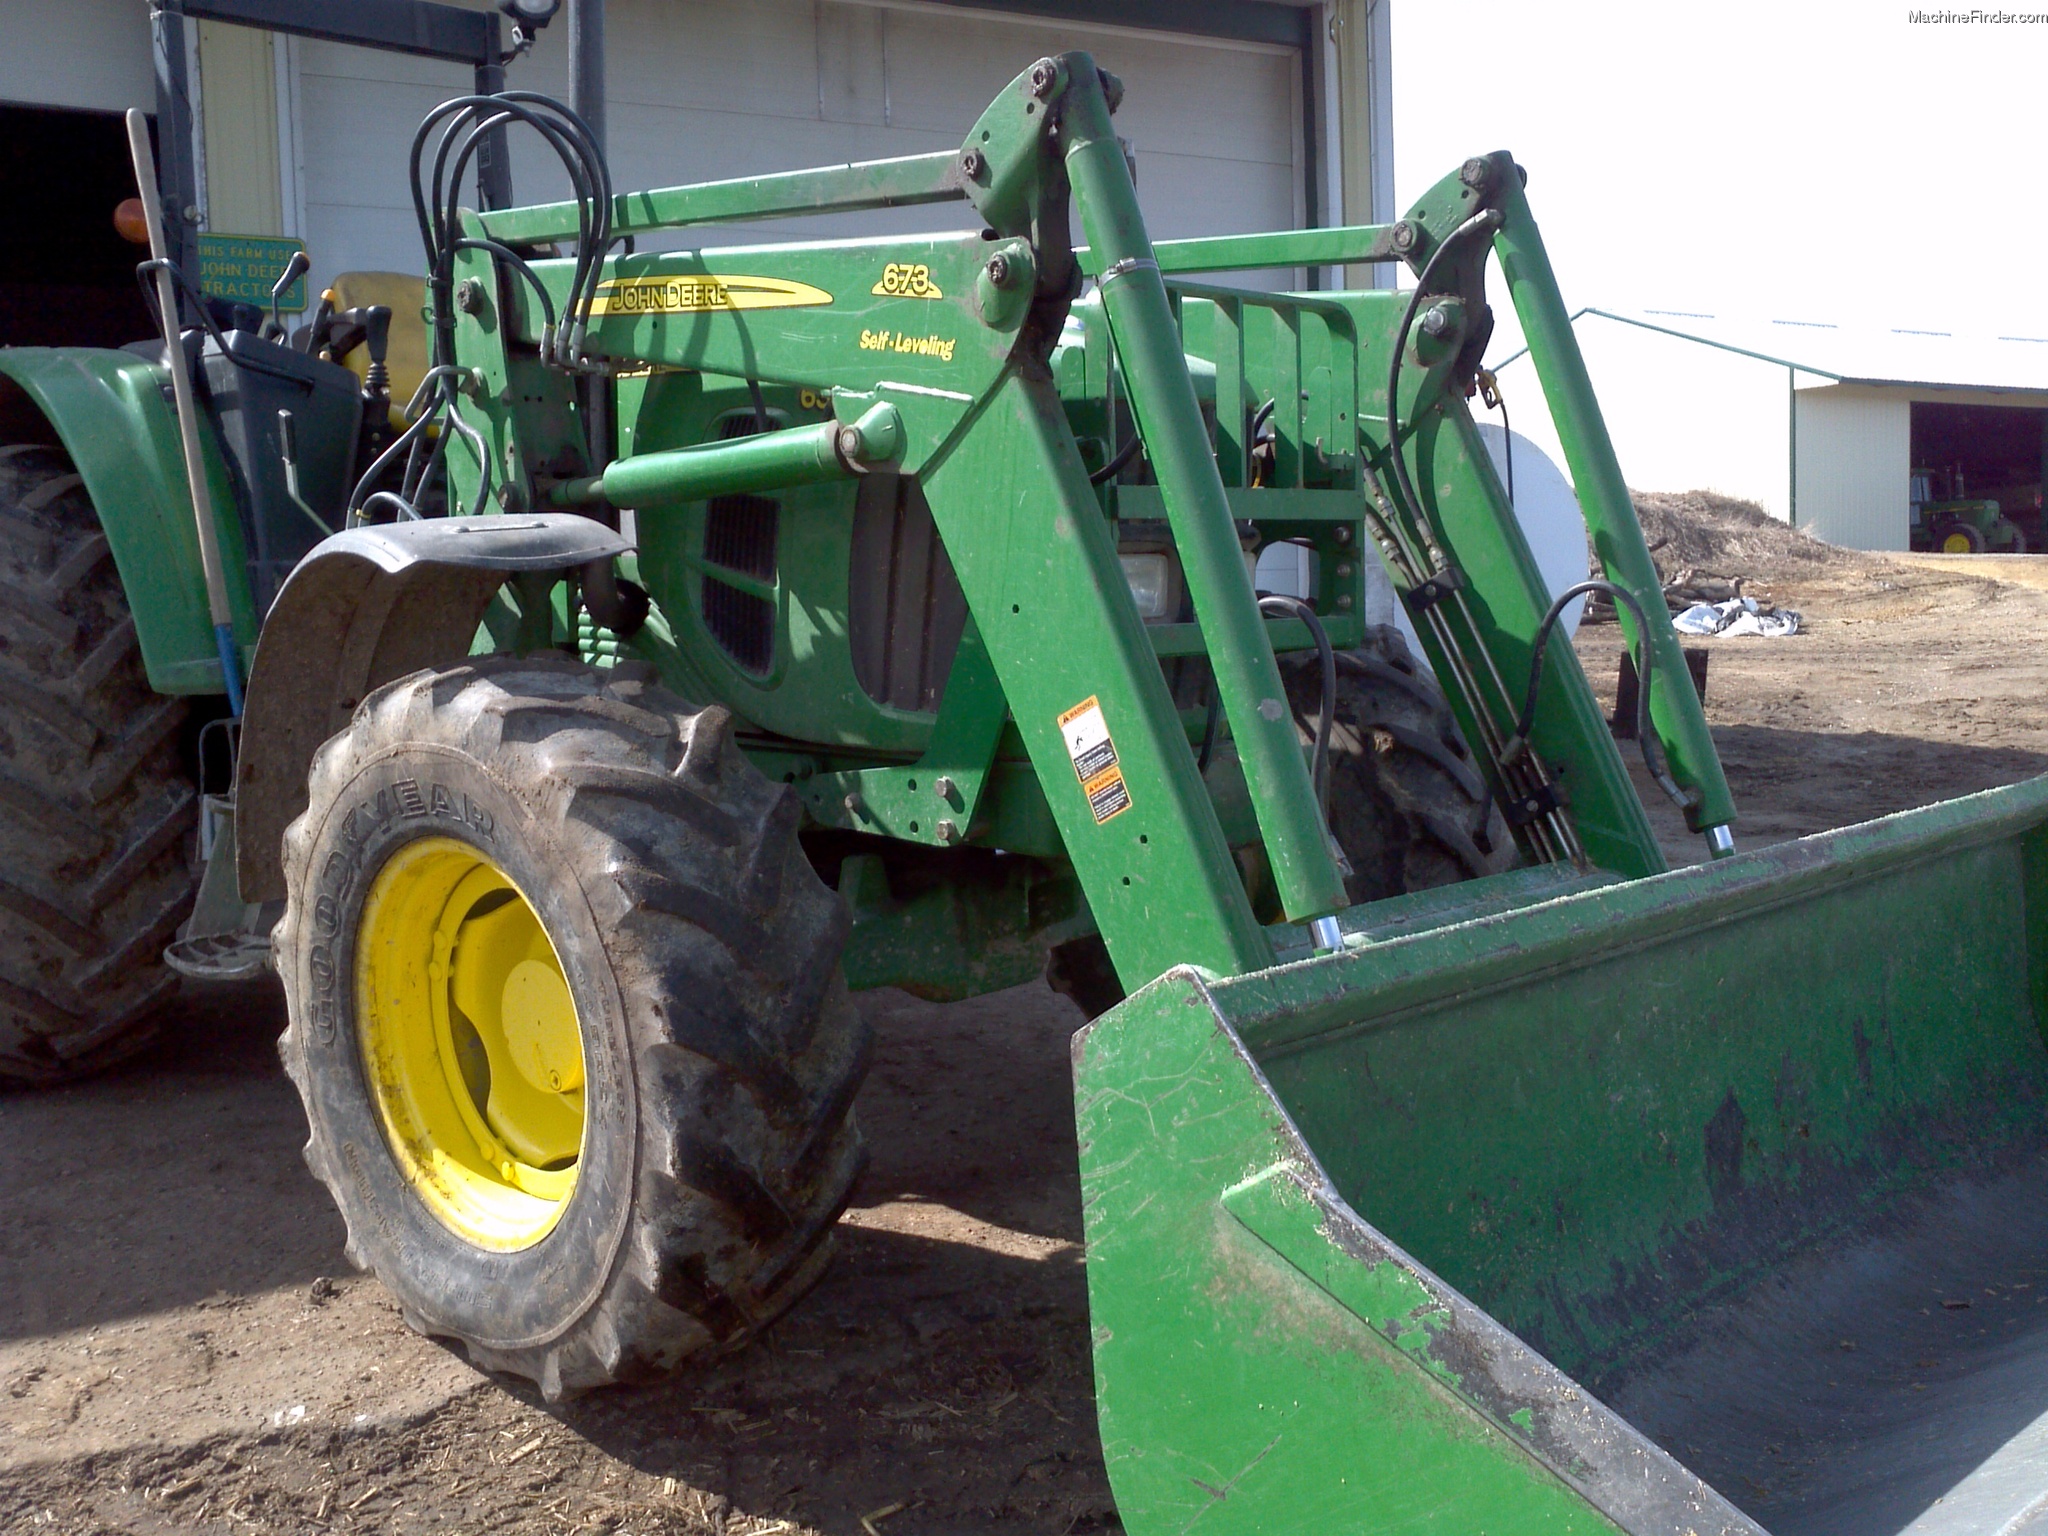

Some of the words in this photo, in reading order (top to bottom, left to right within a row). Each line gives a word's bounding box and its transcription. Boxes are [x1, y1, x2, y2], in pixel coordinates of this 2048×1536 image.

[230, 246, 263, 258] FARM
[200, 261, 241, 276] JOHN
[882, 263, 931, 297] 673
[203, 281, 296, 299] TRACTOS
